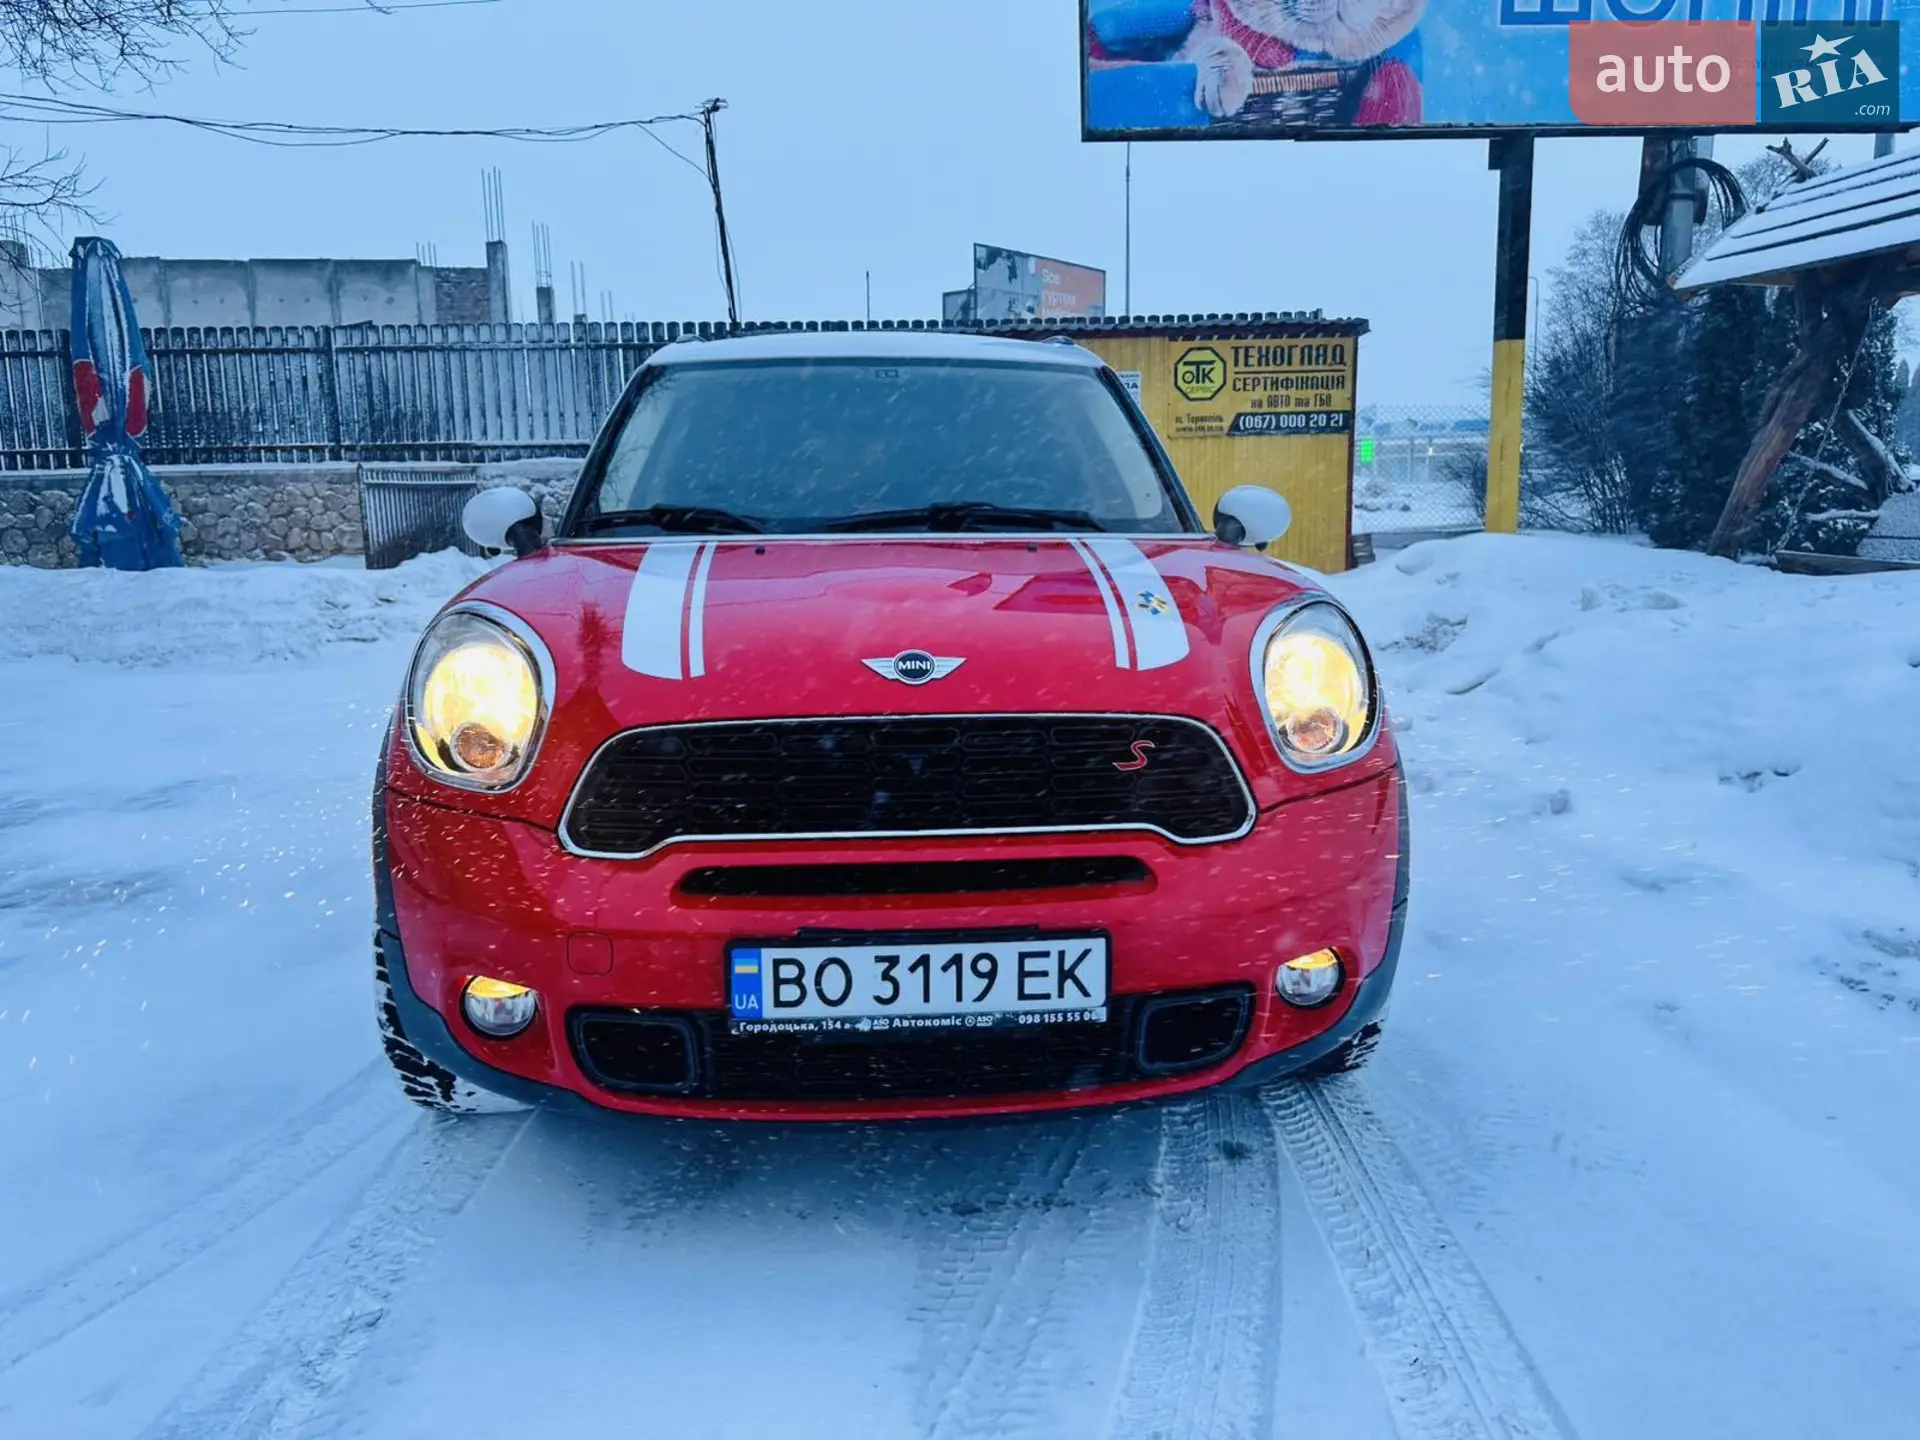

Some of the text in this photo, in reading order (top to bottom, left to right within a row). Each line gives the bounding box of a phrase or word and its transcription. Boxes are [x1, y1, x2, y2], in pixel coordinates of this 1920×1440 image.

[1231, 343, 1347, 368] ТЕХОГЛЯД
[1232, 375, 1345, 393] СЕРТИФІКАЦІЯ
[1267, 394, 1291, 409] АВТО
[1313, 392, 1332, 408] ГБО
[1238, 414, 1276, 431] (067)
[1279, 413, 1306, 429] 000
[1309, 413, 1327, 428] 20
[1330, 412, 1344, 428] 21
[898, 660, 931, 671] MINI
[1112, 740, 1156, 771] S
[772, 948, 1093, 1009] BO 3119 EK
[735, 994, 759, 1011] UA
[739, 1021, 819, 1034] Городоцька,
[821, 1019, 842, 1031] 154
[892, 1016, 962, 1028] Автокоміс
[1019, 1013, 1041, 1025] 098
[1043, 1012, 1064, 1024] 155
[1066, 1011, 1081, 1023] 55
